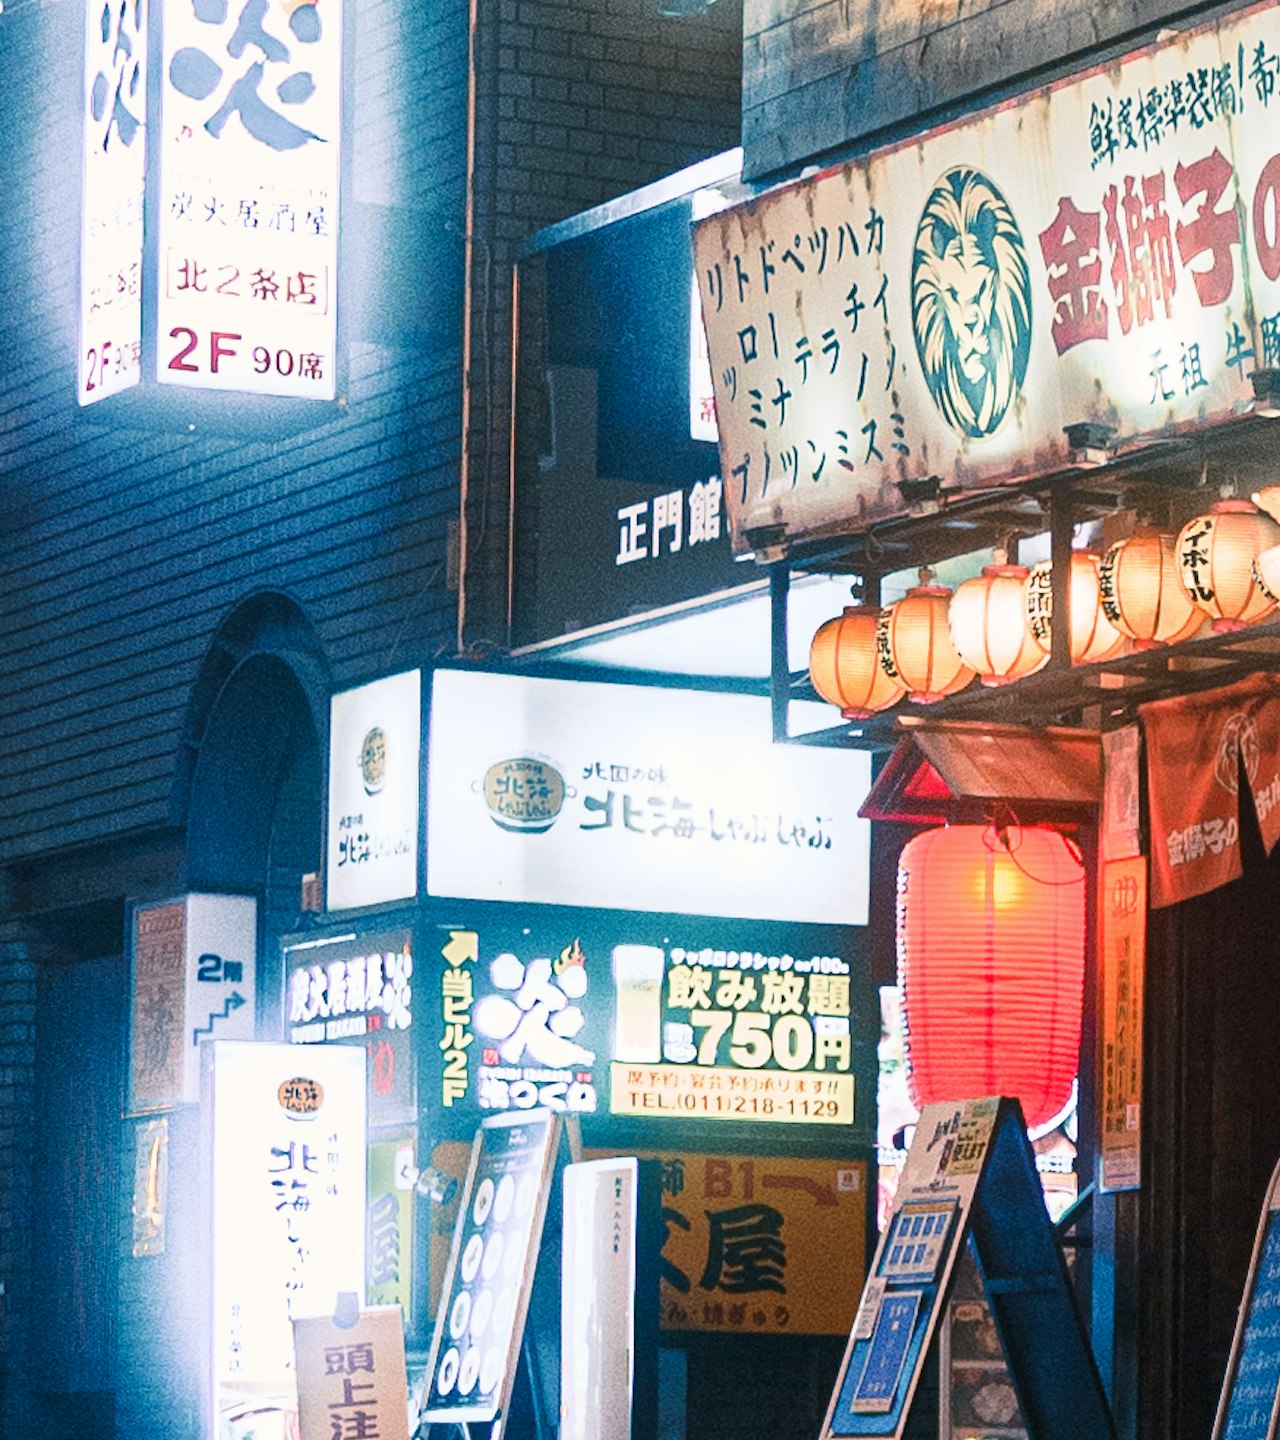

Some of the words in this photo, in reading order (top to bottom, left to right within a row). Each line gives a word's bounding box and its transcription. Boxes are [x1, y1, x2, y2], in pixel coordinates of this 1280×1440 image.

[168, 326, 242, 374] 2F
[579, 790, 832, 849] 北海しゃぶしゃぶ
[668, 965, 851, 1016] 飲み放題
[439, 969, 473, 1107] 当ビル2F
[692, 1011, 850, 1071] 750円
[705, 1160, 753, 1200] B1
